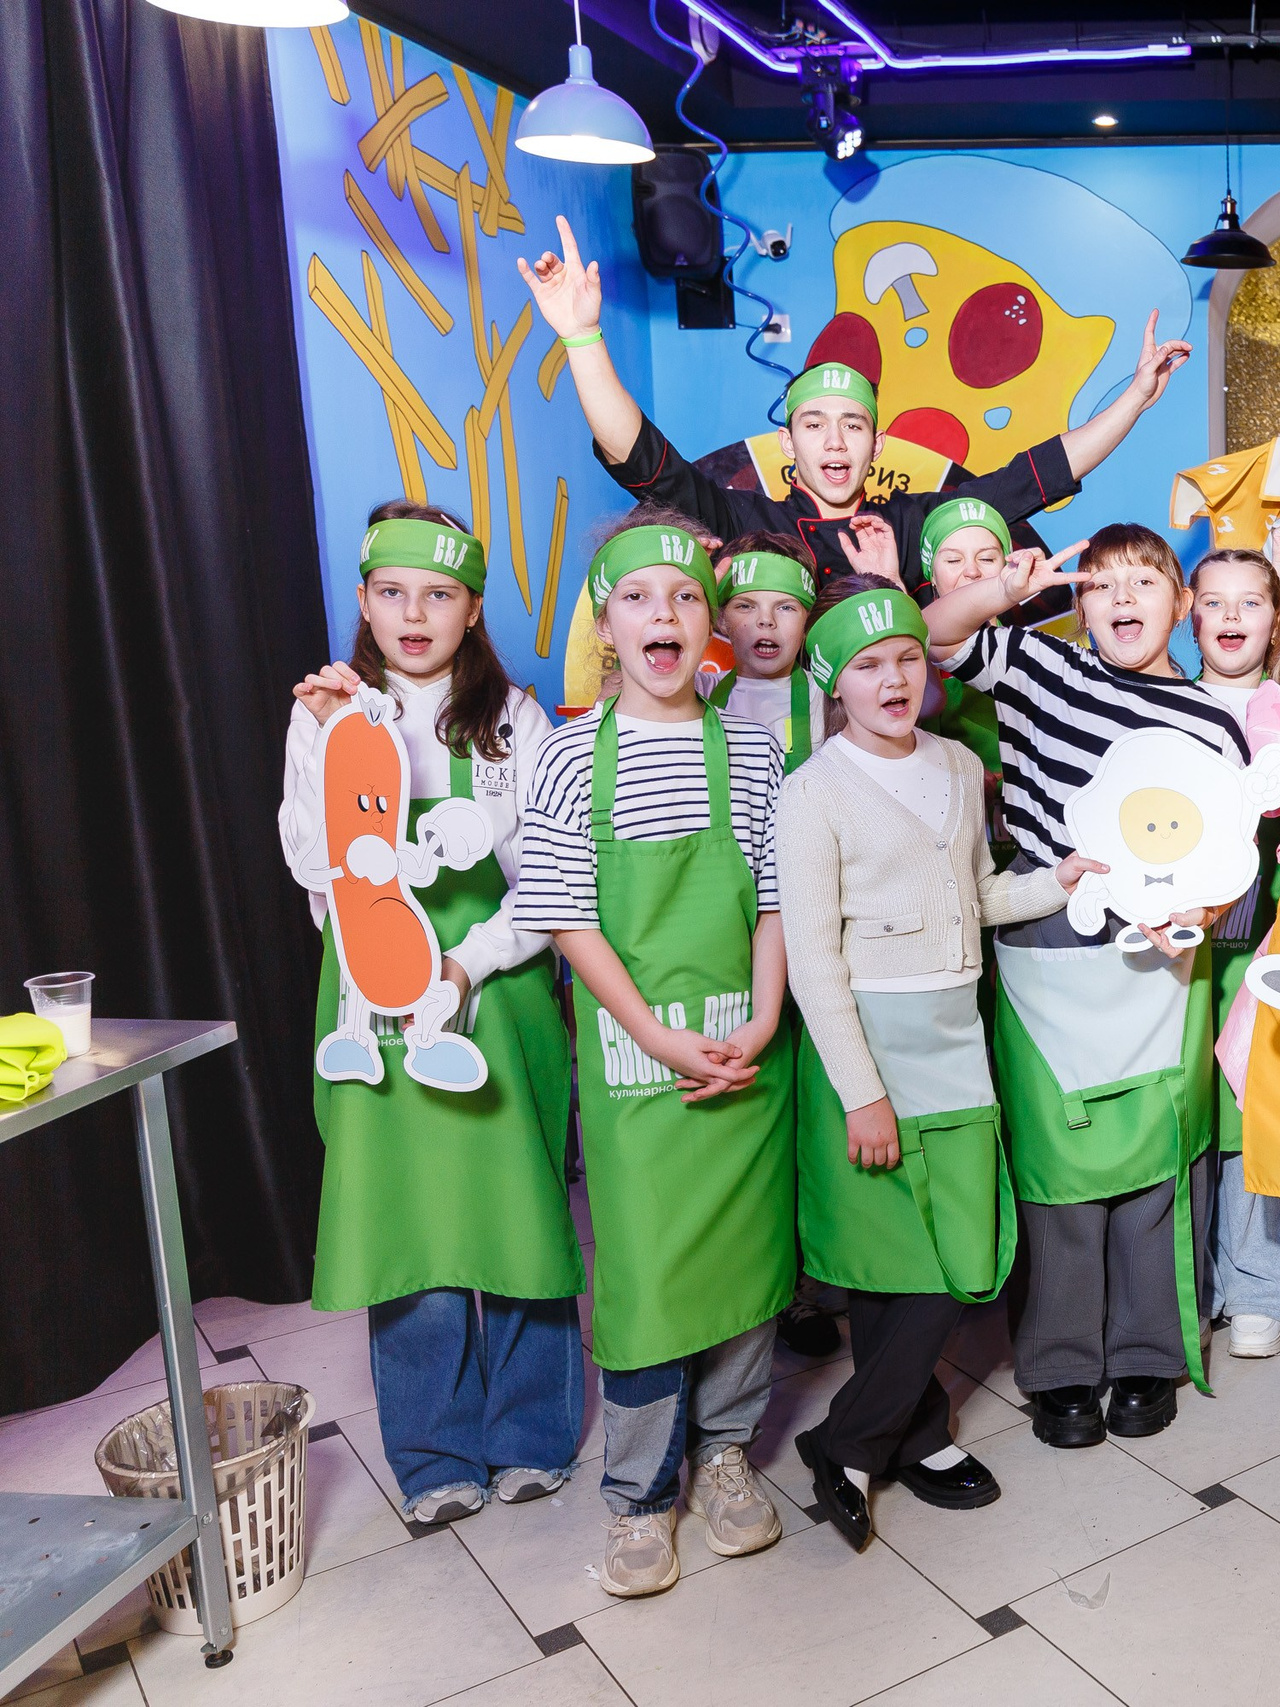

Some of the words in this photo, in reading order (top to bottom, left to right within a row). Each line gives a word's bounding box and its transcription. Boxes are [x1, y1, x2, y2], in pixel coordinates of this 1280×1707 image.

[823, 369, 851, 390] C&R
[959, 502, 986, 522] C&R
[433, 534, 468, 571] C&R
[660, 534, 695, 566] C&R
[732, 557, 758, 588] C&R
[857, 599, 893, 636] C&R
[480, 779, 510, 789] MOUSE
[485, 789, 503, 798] 1928
